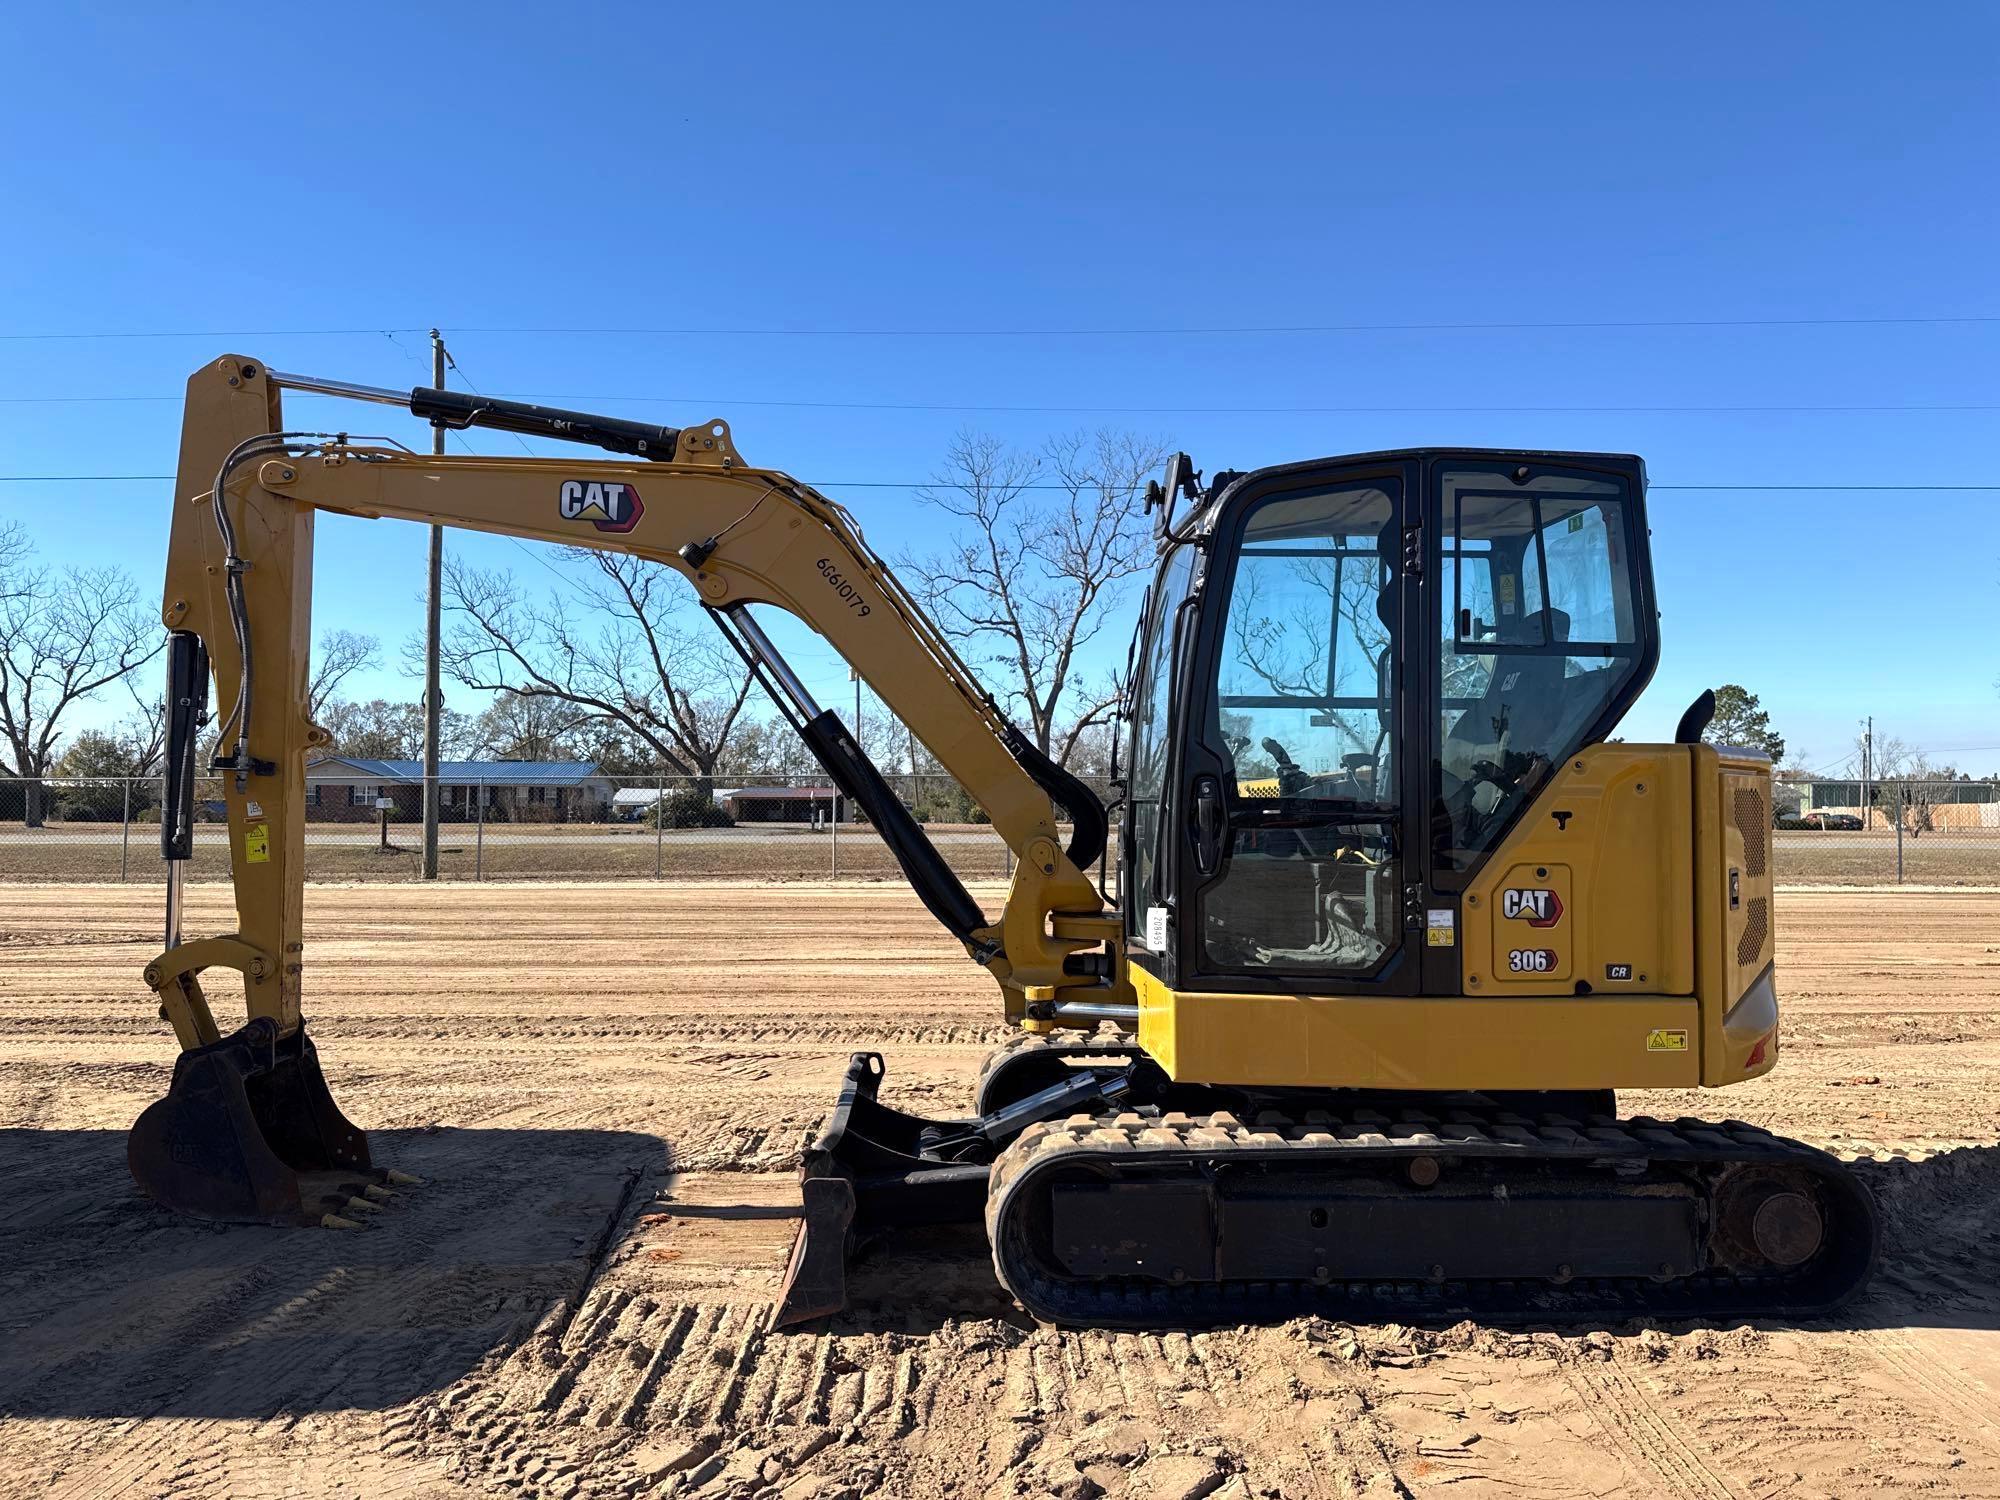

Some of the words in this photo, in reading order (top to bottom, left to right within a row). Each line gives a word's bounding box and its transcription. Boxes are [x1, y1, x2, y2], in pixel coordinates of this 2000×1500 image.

[561, 480, 625, 521] CAT
[817, 558, 871, 617] 6G610179
[1503, 889, 1549, 919] CAT
[1153, 916, 1163, 945] 208495
[1509, 950, 1547, 972] 306
[1611, 967, 1627, 978] CR
